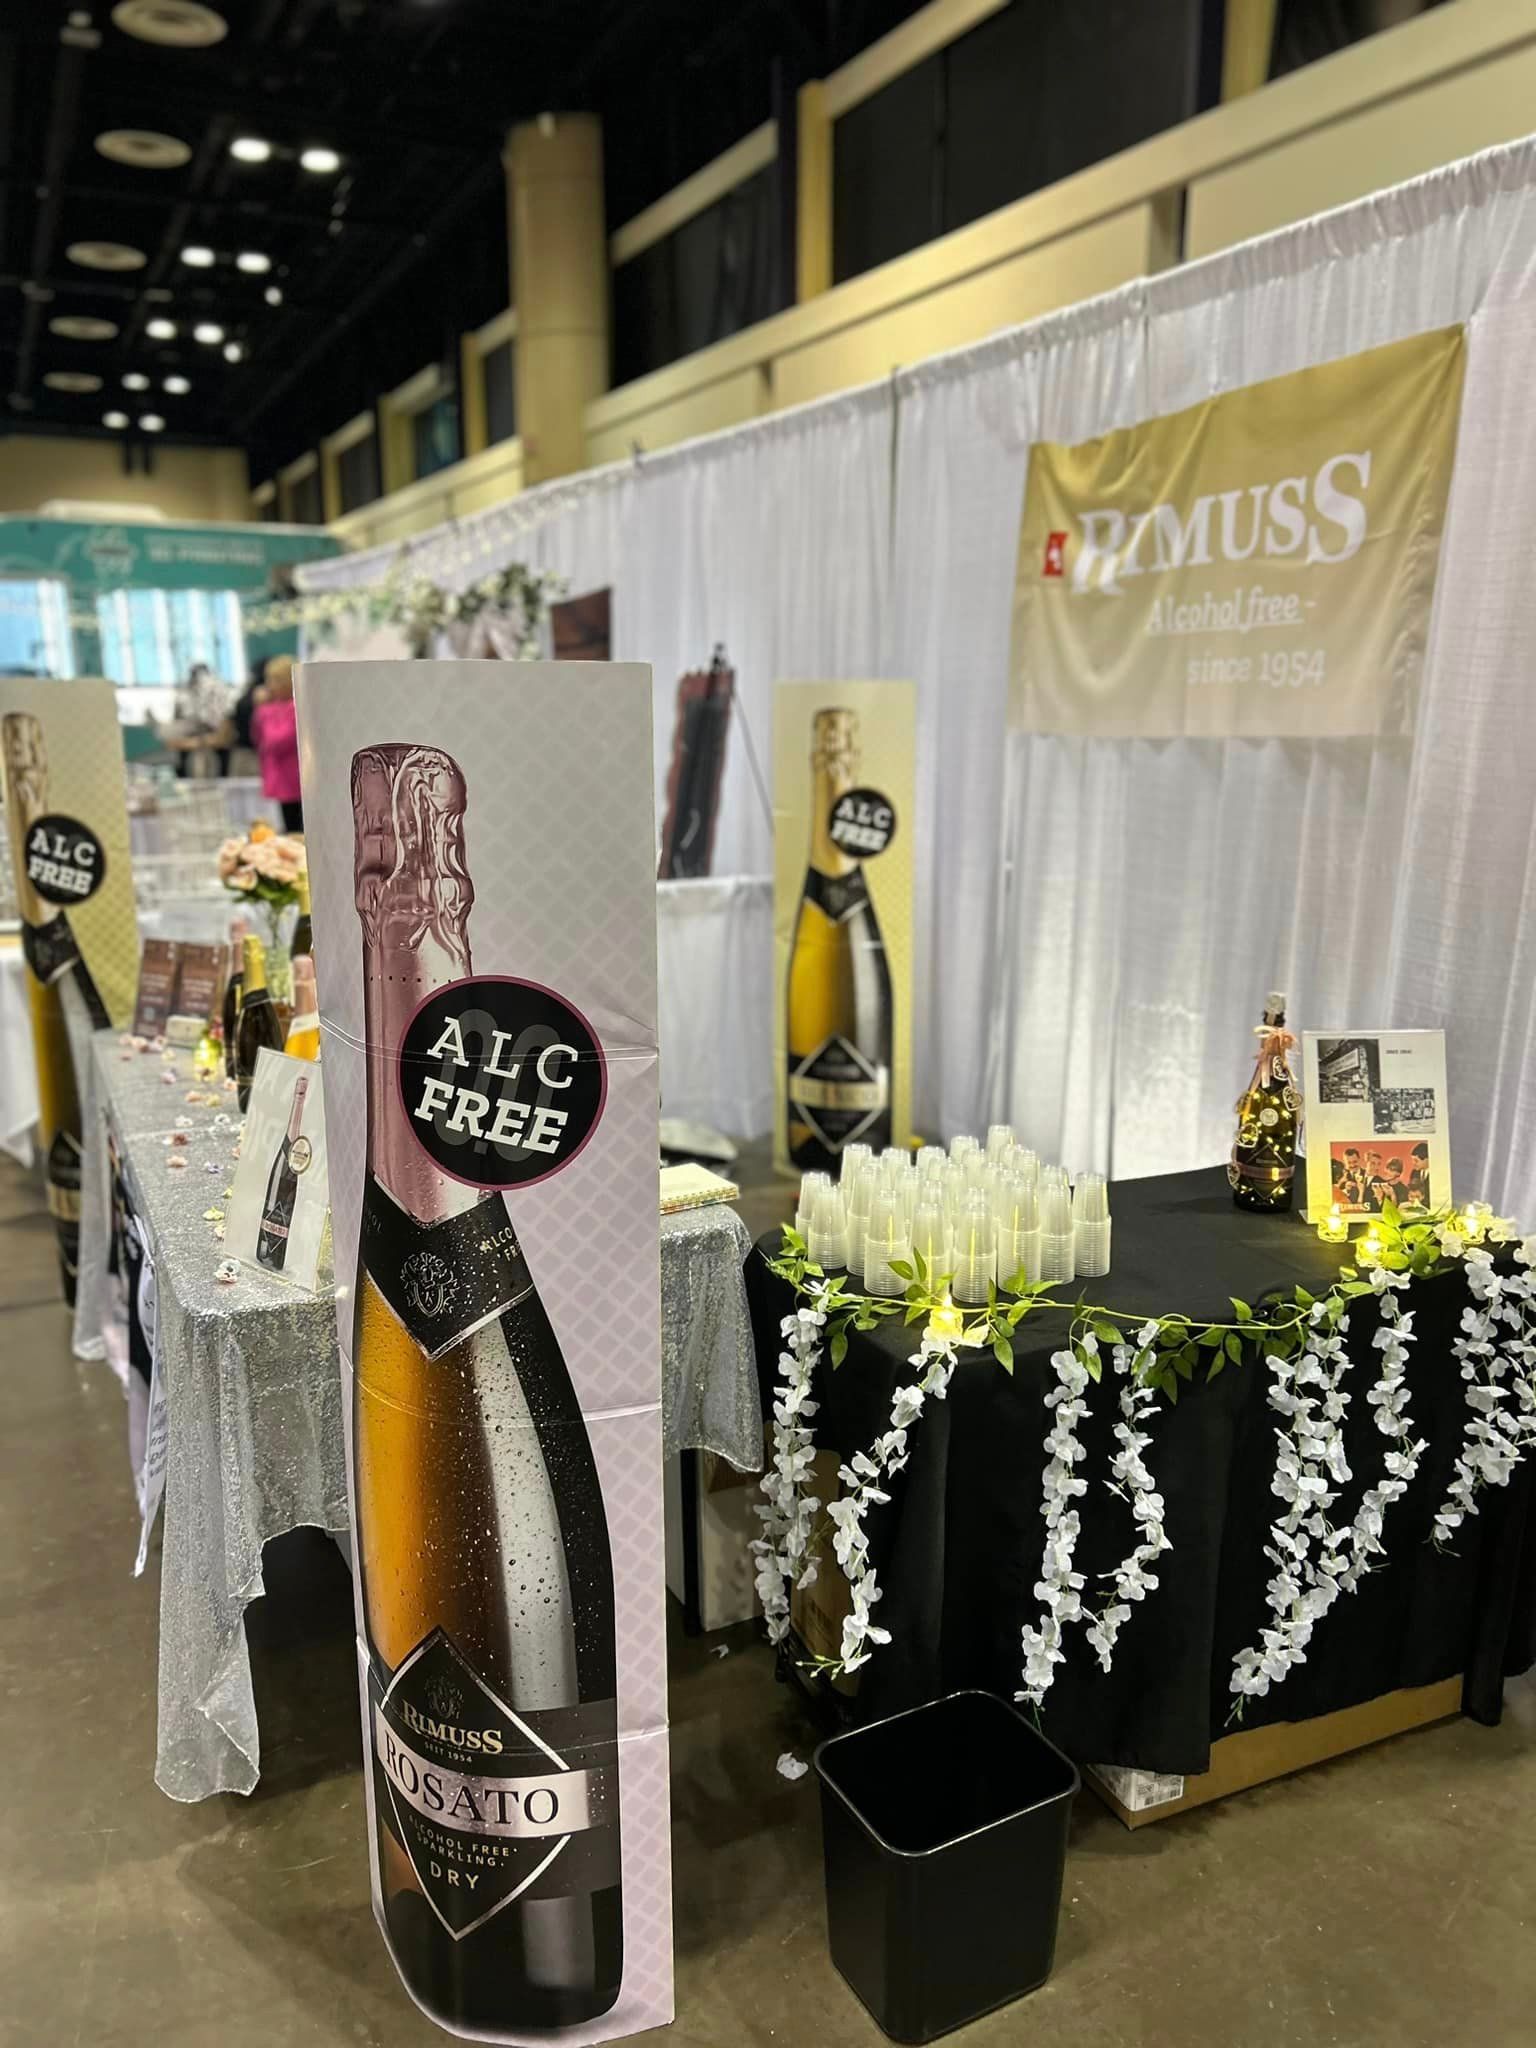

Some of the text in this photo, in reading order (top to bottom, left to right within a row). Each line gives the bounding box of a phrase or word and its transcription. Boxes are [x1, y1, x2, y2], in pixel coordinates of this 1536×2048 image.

[1071, 451, 1372, 595] RIMUSS
[1187, 650, 1325, 687] since 1954
[836, 798, 892, 829] ALC
[29, 827, 97, 867] ALC
[832, 819, 888, 851] FREE
[28, 856, 94, 895] FREE
[426, 1016, 579, 1089] ALC
[413, 1076, 569, 1155] FREE
[400, 1698, 503, 1755] RIMUSS
[447, 1750, 473, 1764] 1954
[384, 1730, 560, 1825] ROSATO
[472, 1843, 510, 1857] FREE
[430, 1860, 480, 1890] DRY
